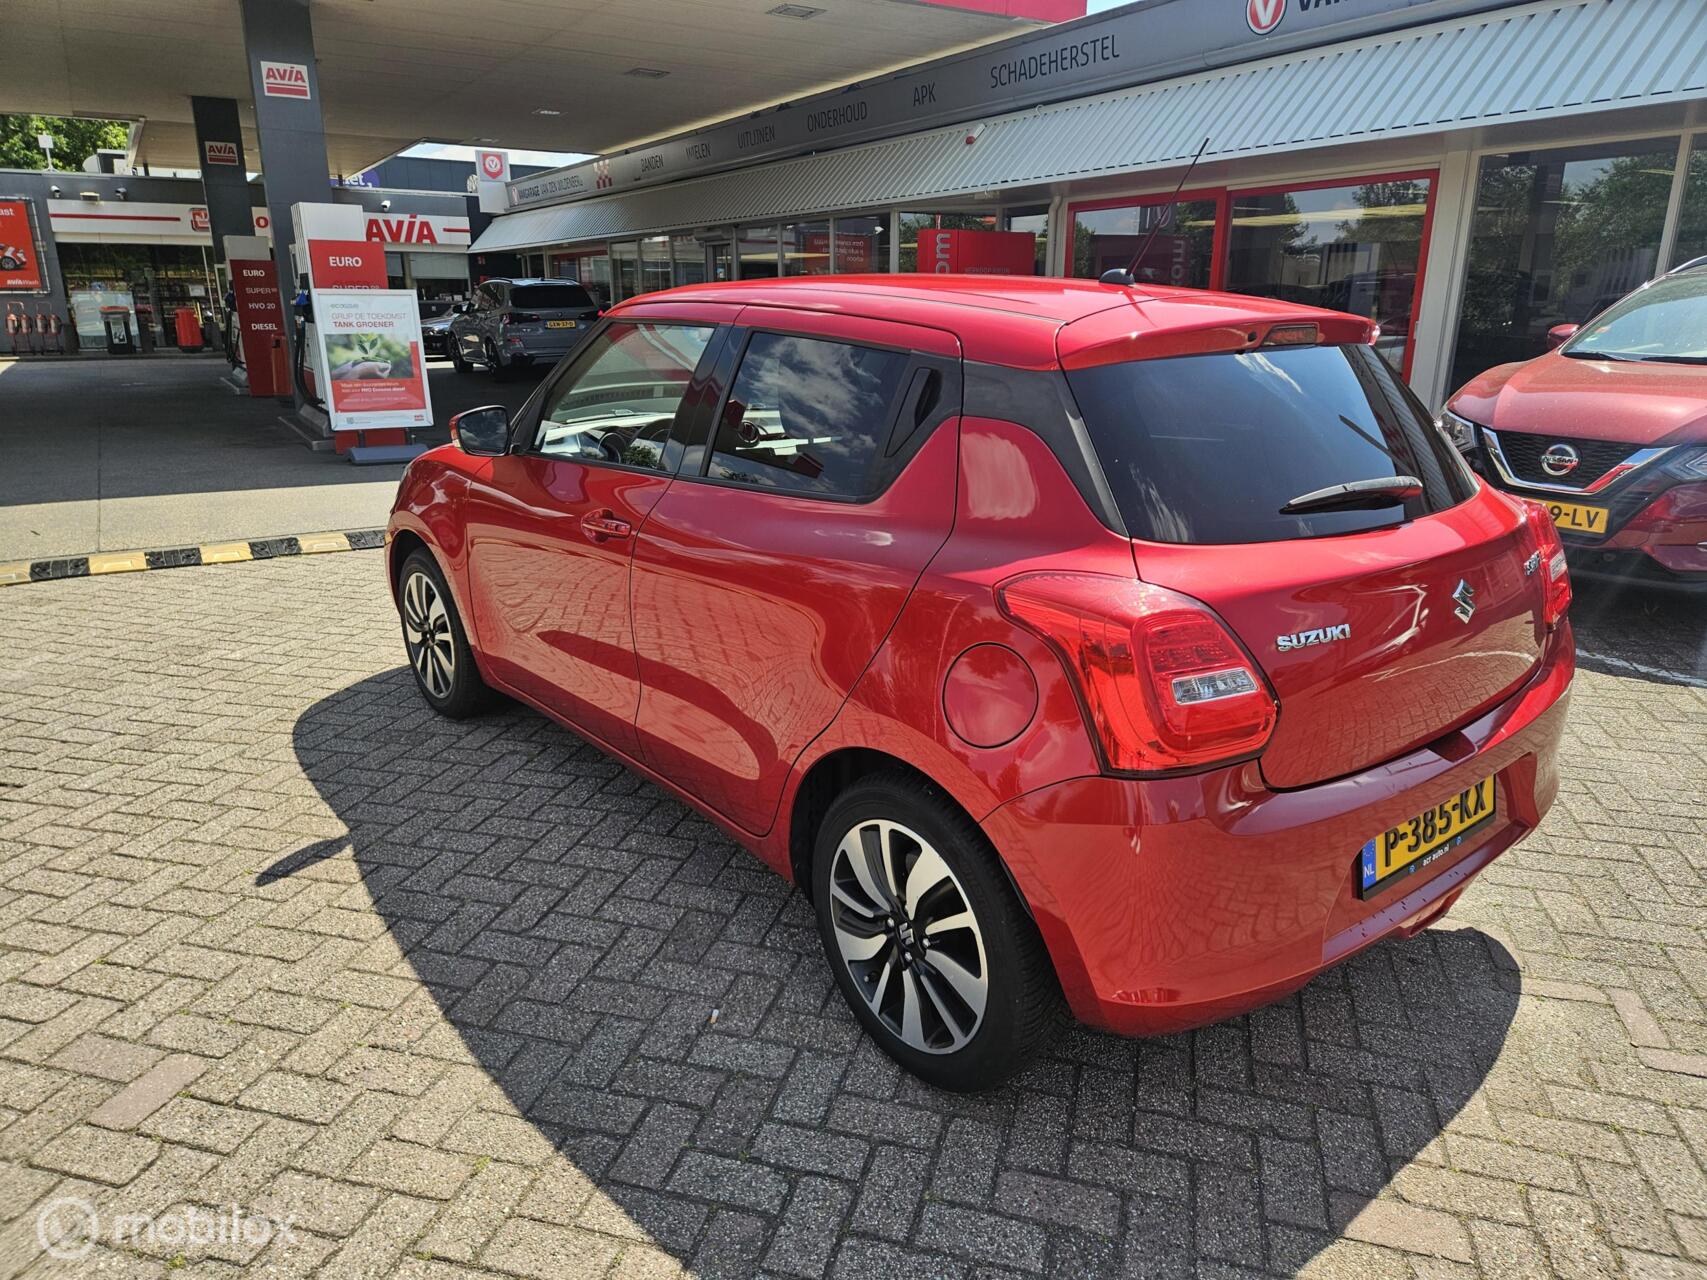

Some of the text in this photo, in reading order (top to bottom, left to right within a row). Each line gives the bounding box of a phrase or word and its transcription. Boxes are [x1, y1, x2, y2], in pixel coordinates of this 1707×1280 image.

[990, 34, 1120, 89] SCHADEHERSTEL
[913, 81, 936, 106] APK
[807, 101, 868, 133] ONDERHOUD
[685, 143, 711, 161] WIELEN
[641, 154, 664, 173] BANDEN
[329, 256, 362, 267] EURO
[242, 269, 265, 277] EURO
[251, 323, 278, 331] DIESEL
[1543, 456, 1576, 464] NISSAN
[1276, 623, 1351, 652] SUZUKI
[1384, 780, 1486, 867] P-385-KX
[1363, 864, 1375, 878] NL
